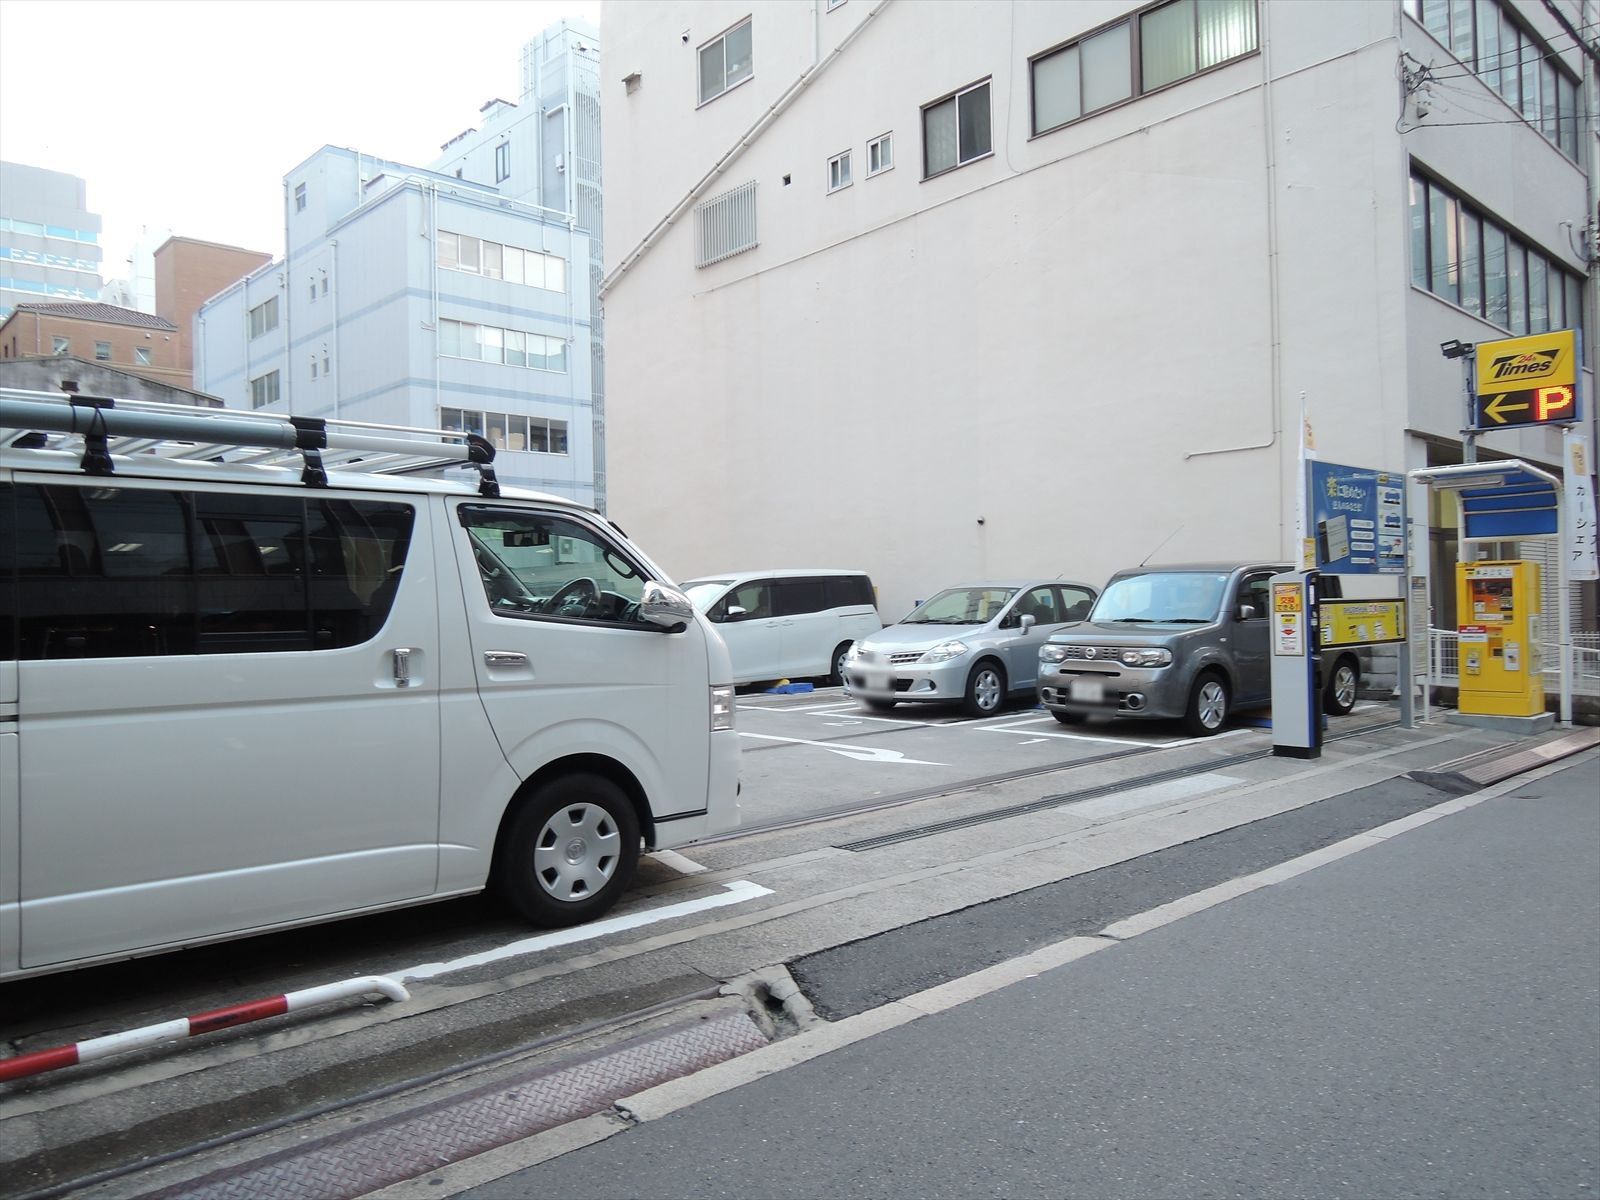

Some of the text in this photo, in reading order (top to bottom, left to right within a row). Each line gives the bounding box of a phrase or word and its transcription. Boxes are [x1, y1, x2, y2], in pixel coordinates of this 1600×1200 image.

[1492, 359, 1552, 379] Times
[1537, 385, 1573, 420] P
[1572, 486, 1588, 562] カーシェア
